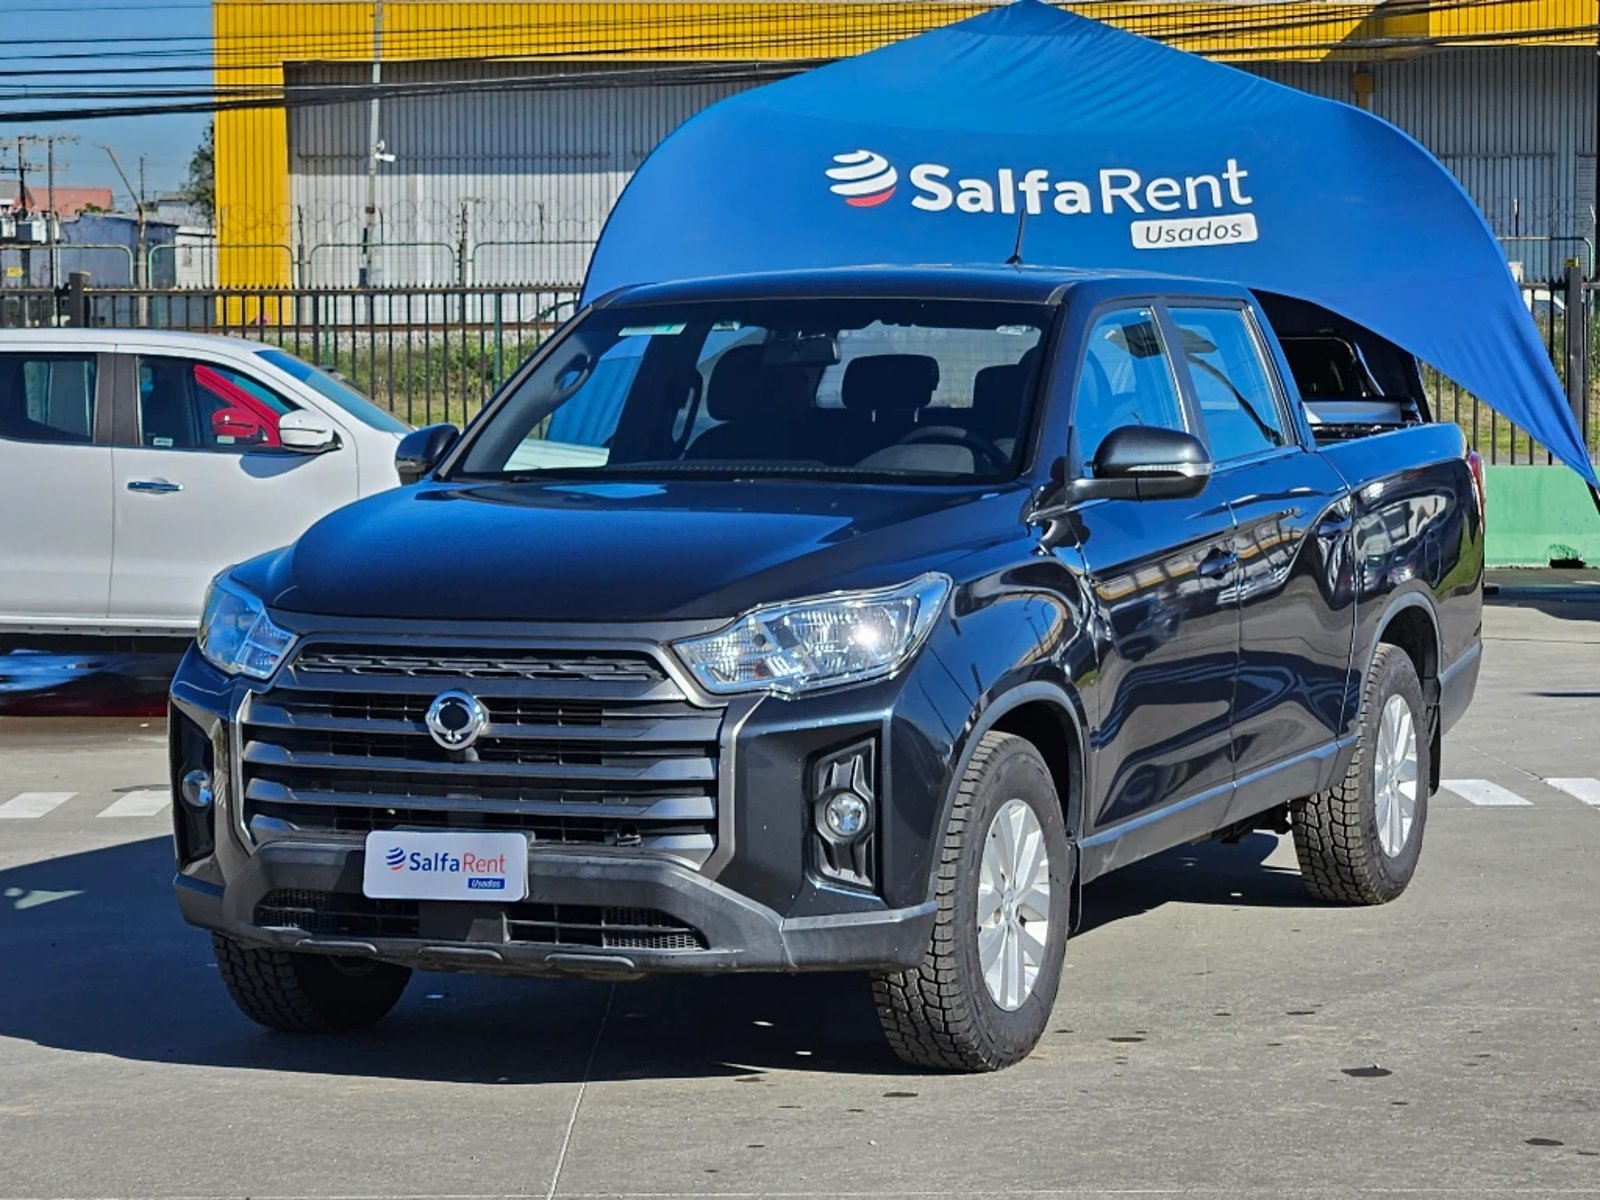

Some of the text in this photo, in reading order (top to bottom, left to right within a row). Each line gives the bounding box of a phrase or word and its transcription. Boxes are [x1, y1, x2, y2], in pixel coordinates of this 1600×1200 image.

[910, 158, 1253, 214] SalfaRent
[1145, 220, 1243, 244] Usados
[409, 852, 506, 873] SalfaRent
[471, 879, 501, 888] Usados
